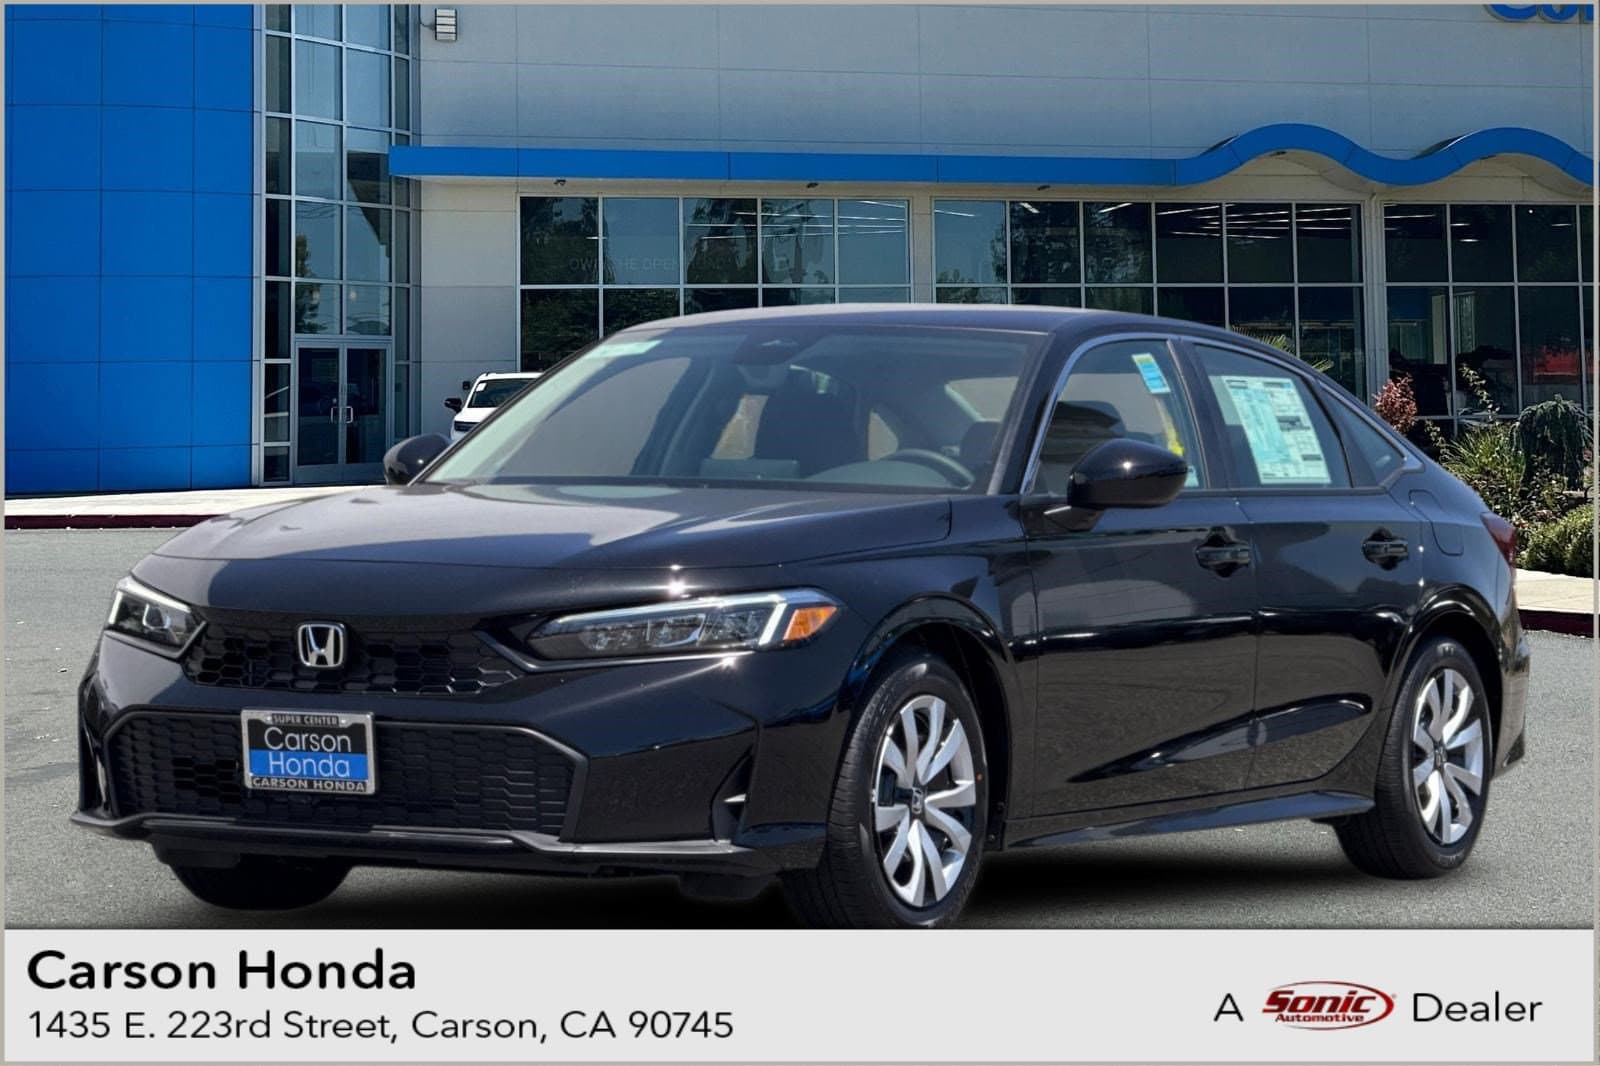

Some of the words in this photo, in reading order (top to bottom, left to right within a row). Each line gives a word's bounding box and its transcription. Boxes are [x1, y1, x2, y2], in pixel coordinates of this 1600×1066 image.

[273, 714, 301, 724] SUPER
[303, 716, 338, 725] CENTER
[264, 726, 352, 753] Carson
[268, 752, 351, 778] Honda
[253, 777, 308, 789] CARSON
[313, 780, 366, 792] HONDA
